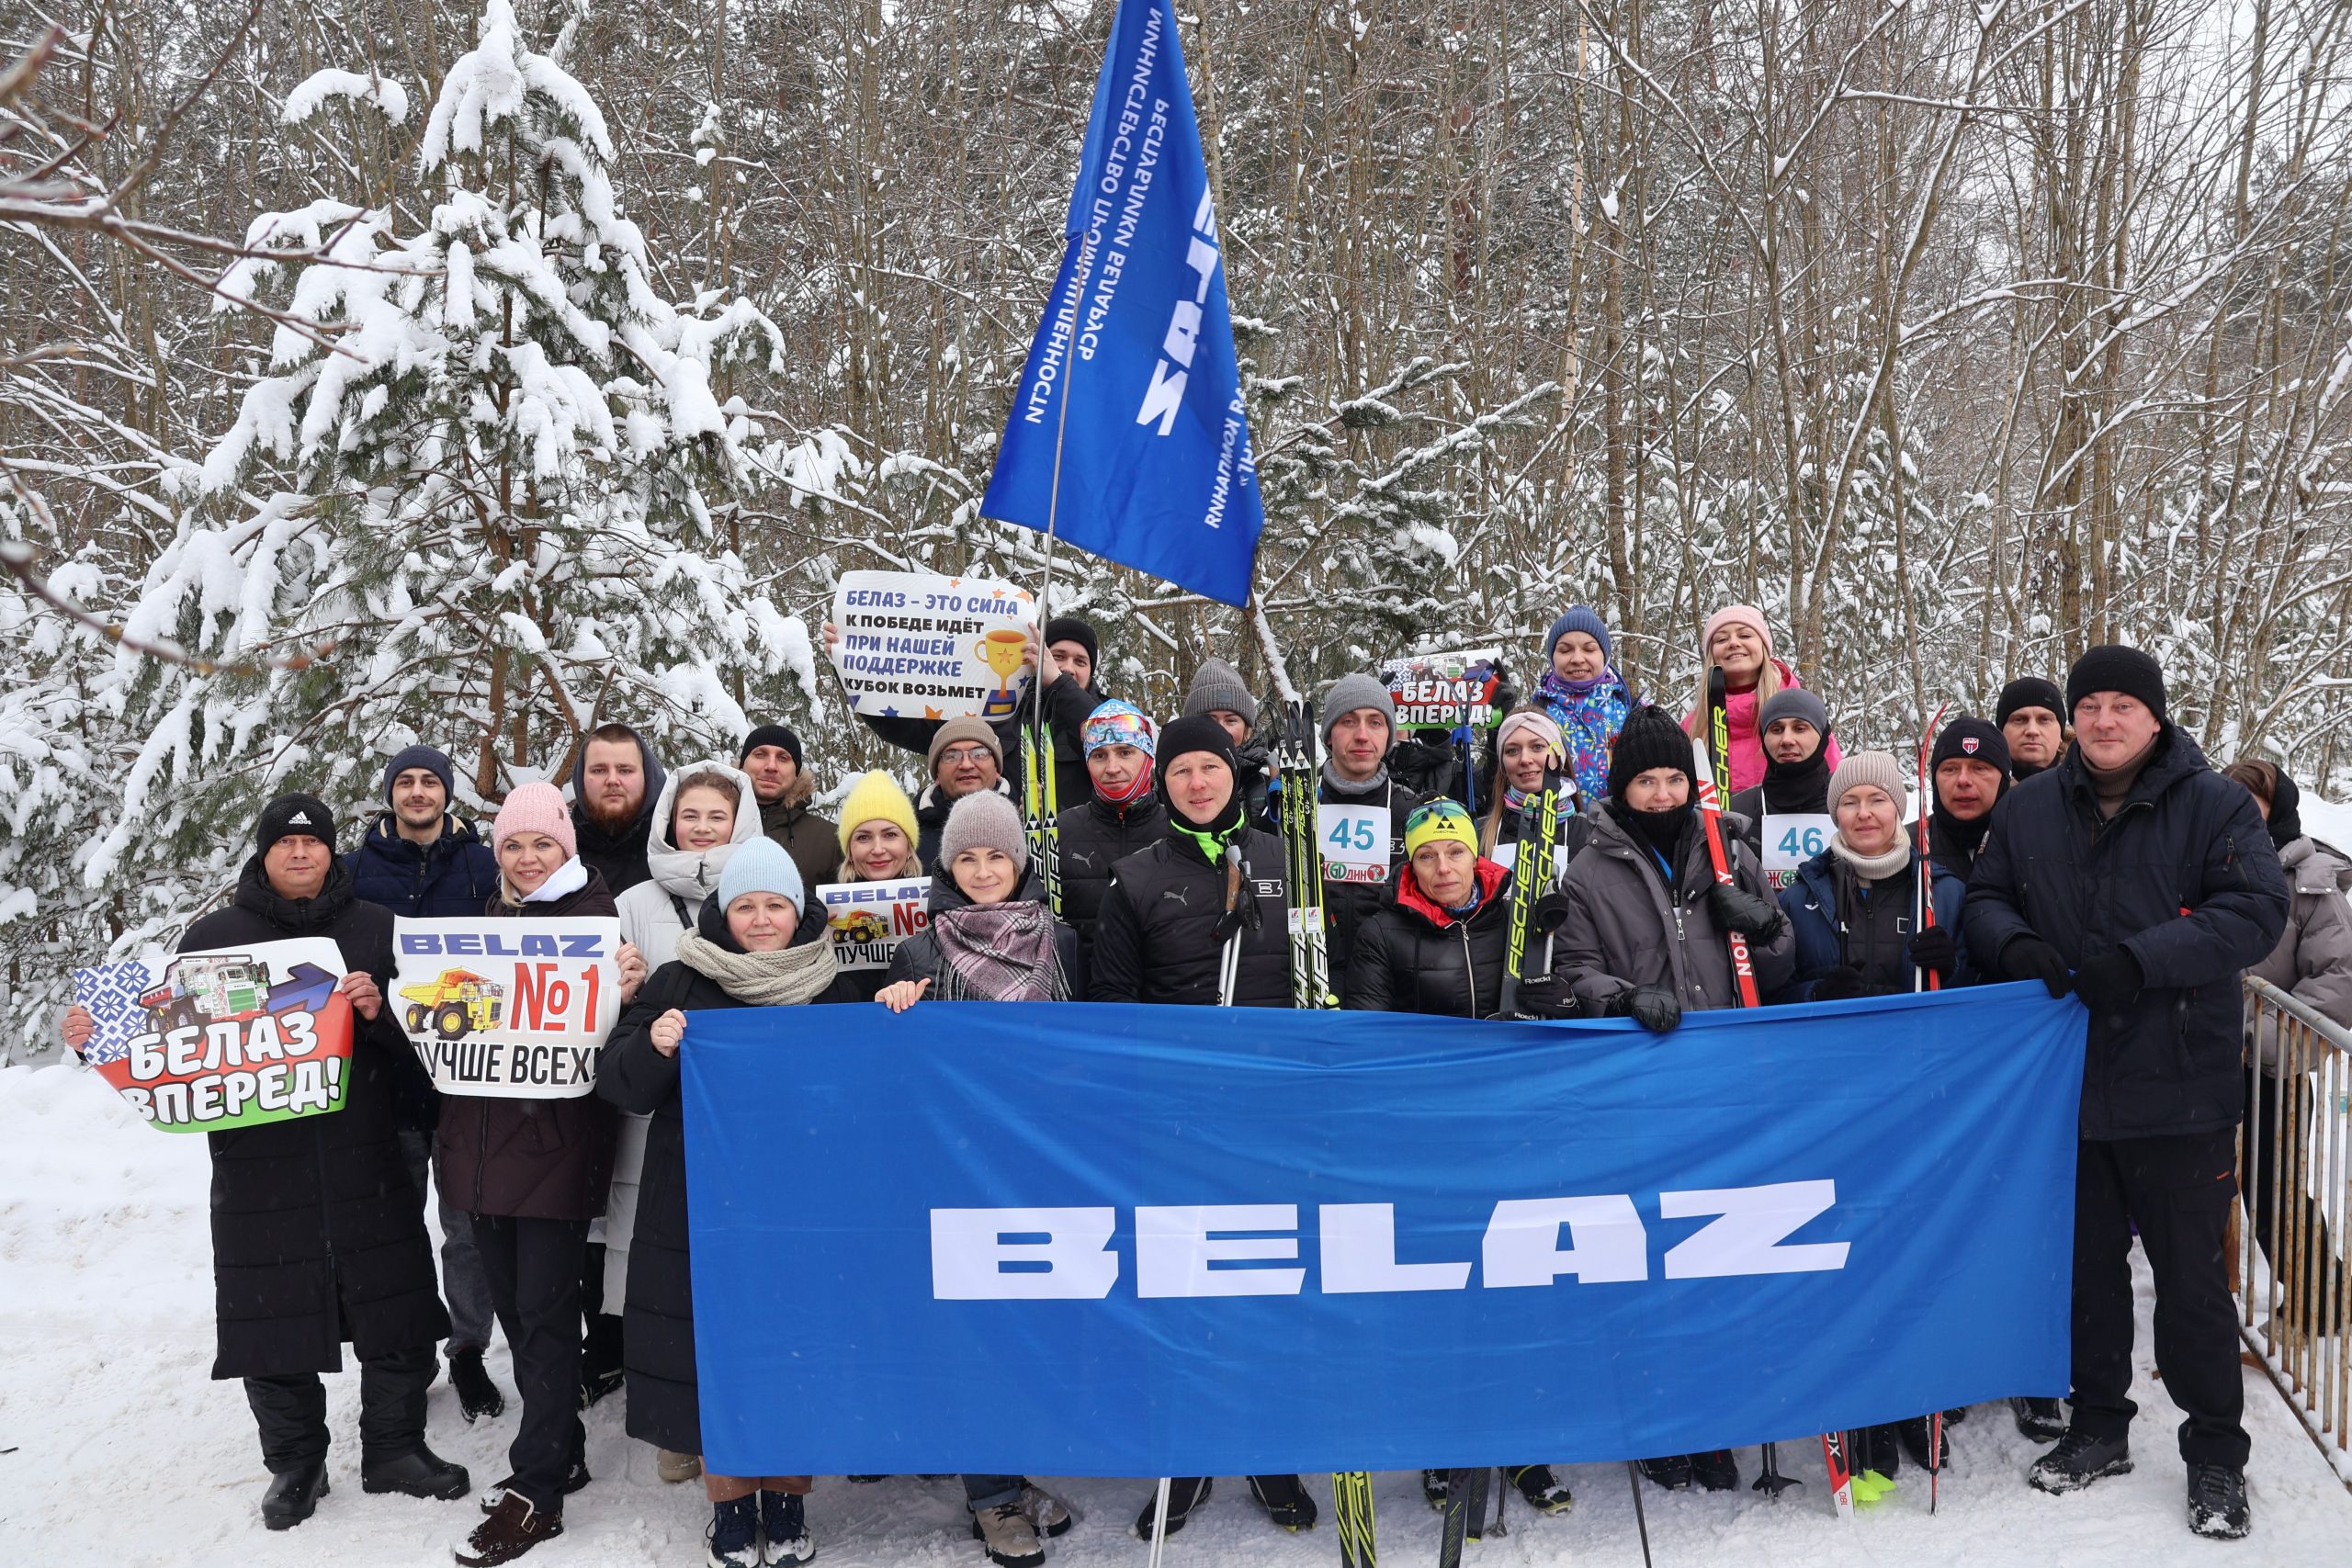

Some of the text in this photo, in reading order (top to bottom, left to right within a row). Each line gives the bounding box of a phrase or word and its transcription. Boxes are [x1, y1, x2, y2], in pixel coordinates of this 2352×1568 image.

[846, 590, 906, 607] БЕЛАЗ
[925, 593, 962, 612] ЭТО
[967, 597, 1018, 615] СИЛА
[846, 615, 985, 635] К ПОБЕДЕ ИДЁТ
[845, 633, 956, 657] ПРИ НАШЕЙ
[842, 654, 964, 677] ПОДДЕРЖКЕ
[844, 677, 986, 699] КУБОК ВОЗЬМЕТ
[1402, 679, 1484, 703] БЕЛАЗ
[1396, 704, 1493, 728] ВПЕРЕД!
[1713, 705, 1730, 811] SCHER
[1281, 773, 1291, 835] FISCHER
[1295, 775, 1307, 838] FISCHER
[1329, 818, 1375, 851] 45
[1778, 827, 1824, 856] 46
[1508, 839, 1533, 980] FISCHER
[400, 933, 605, 958] BELAZ
[127, 1010, 319, 1081] БЕЛАЗ
[119, 1056, 342, 1125] ВПЕРЕД!
[930, 1179, 1850, 1300] BELAZ
